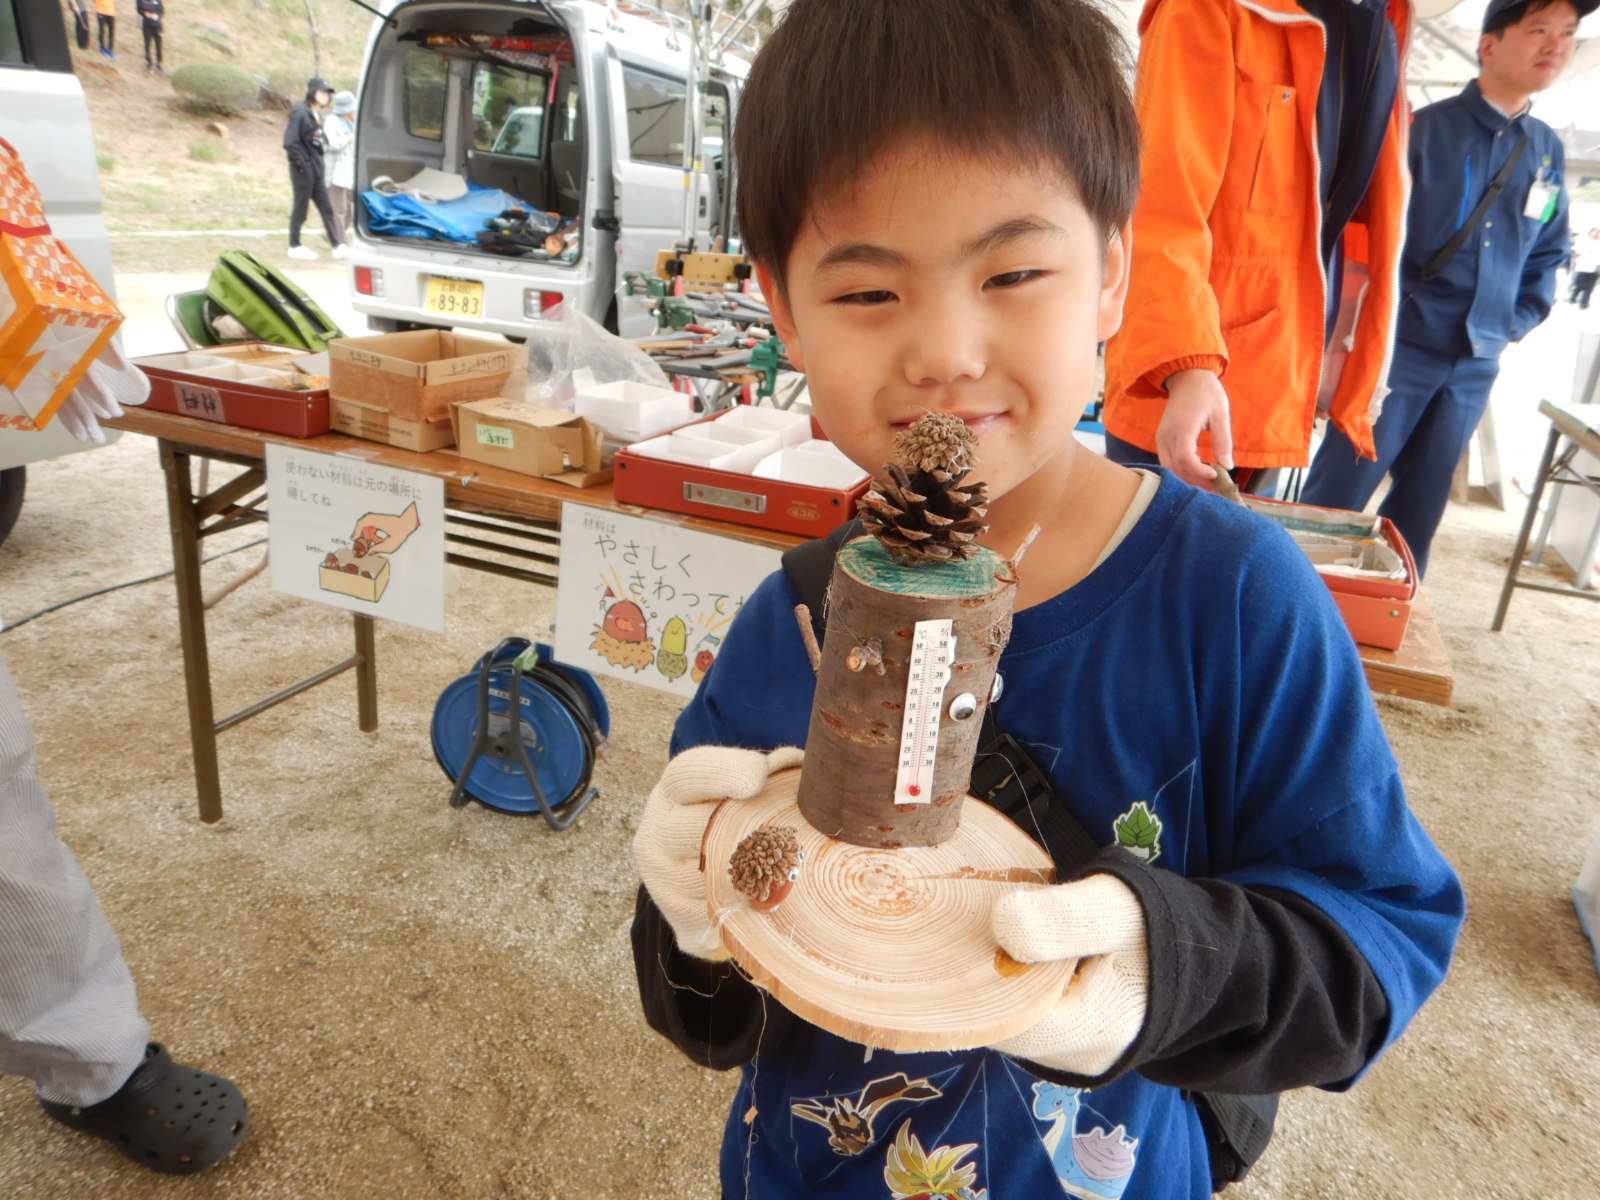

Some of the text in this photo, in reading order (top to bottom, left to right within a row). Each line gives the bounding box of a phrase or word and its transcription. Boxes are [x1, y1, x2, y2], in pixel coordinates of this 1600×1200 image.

[438, 294, 479, 315] 89-83
[594, 534, 692, 578] やさしく
